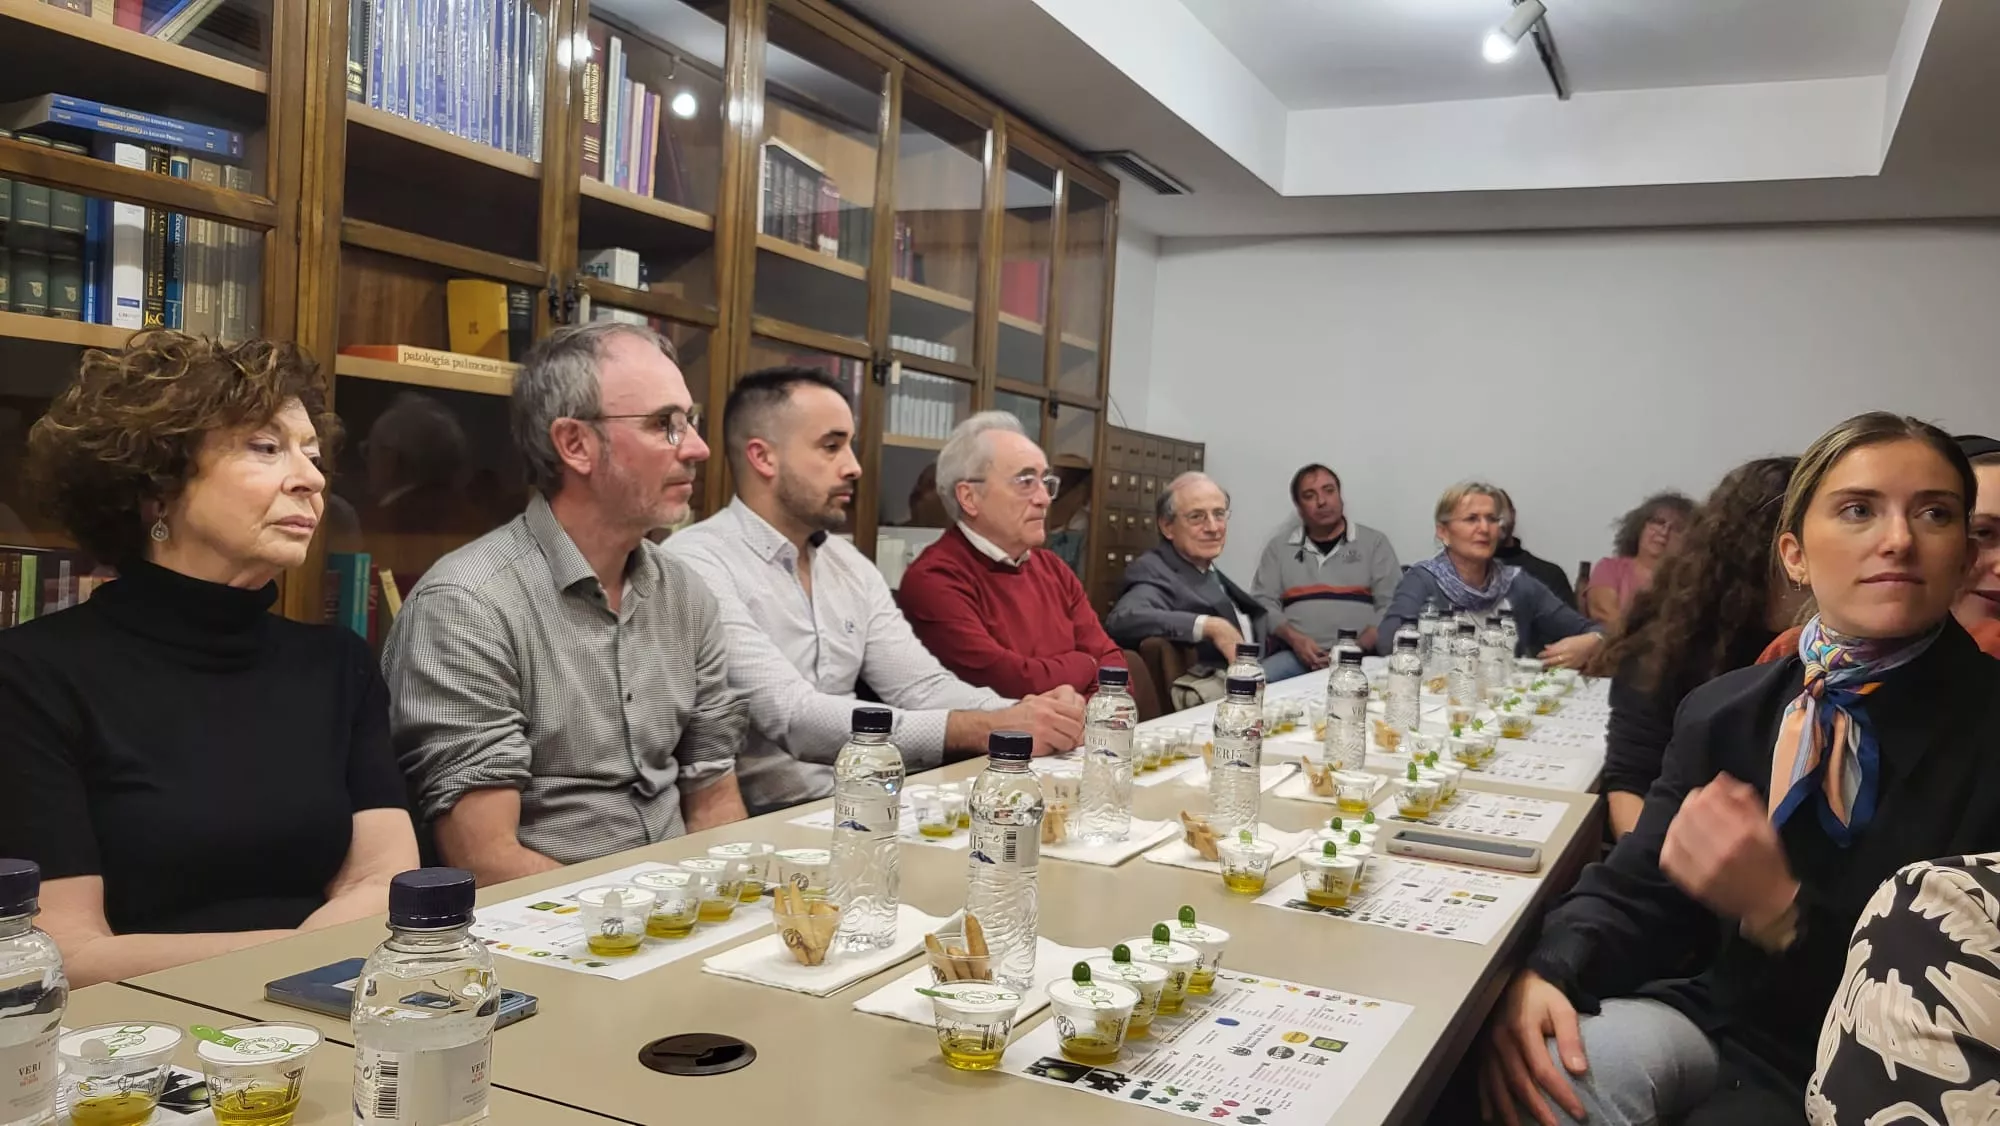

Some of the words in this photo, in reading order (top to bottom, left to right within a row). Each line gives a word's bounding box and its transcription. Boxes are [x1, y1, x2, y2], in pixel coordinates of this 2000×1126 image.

[452, 357, 499, 373] pulmonar
[836, 802, 855, 817] ERI
[19, 1061, 41, 1076] VERI
